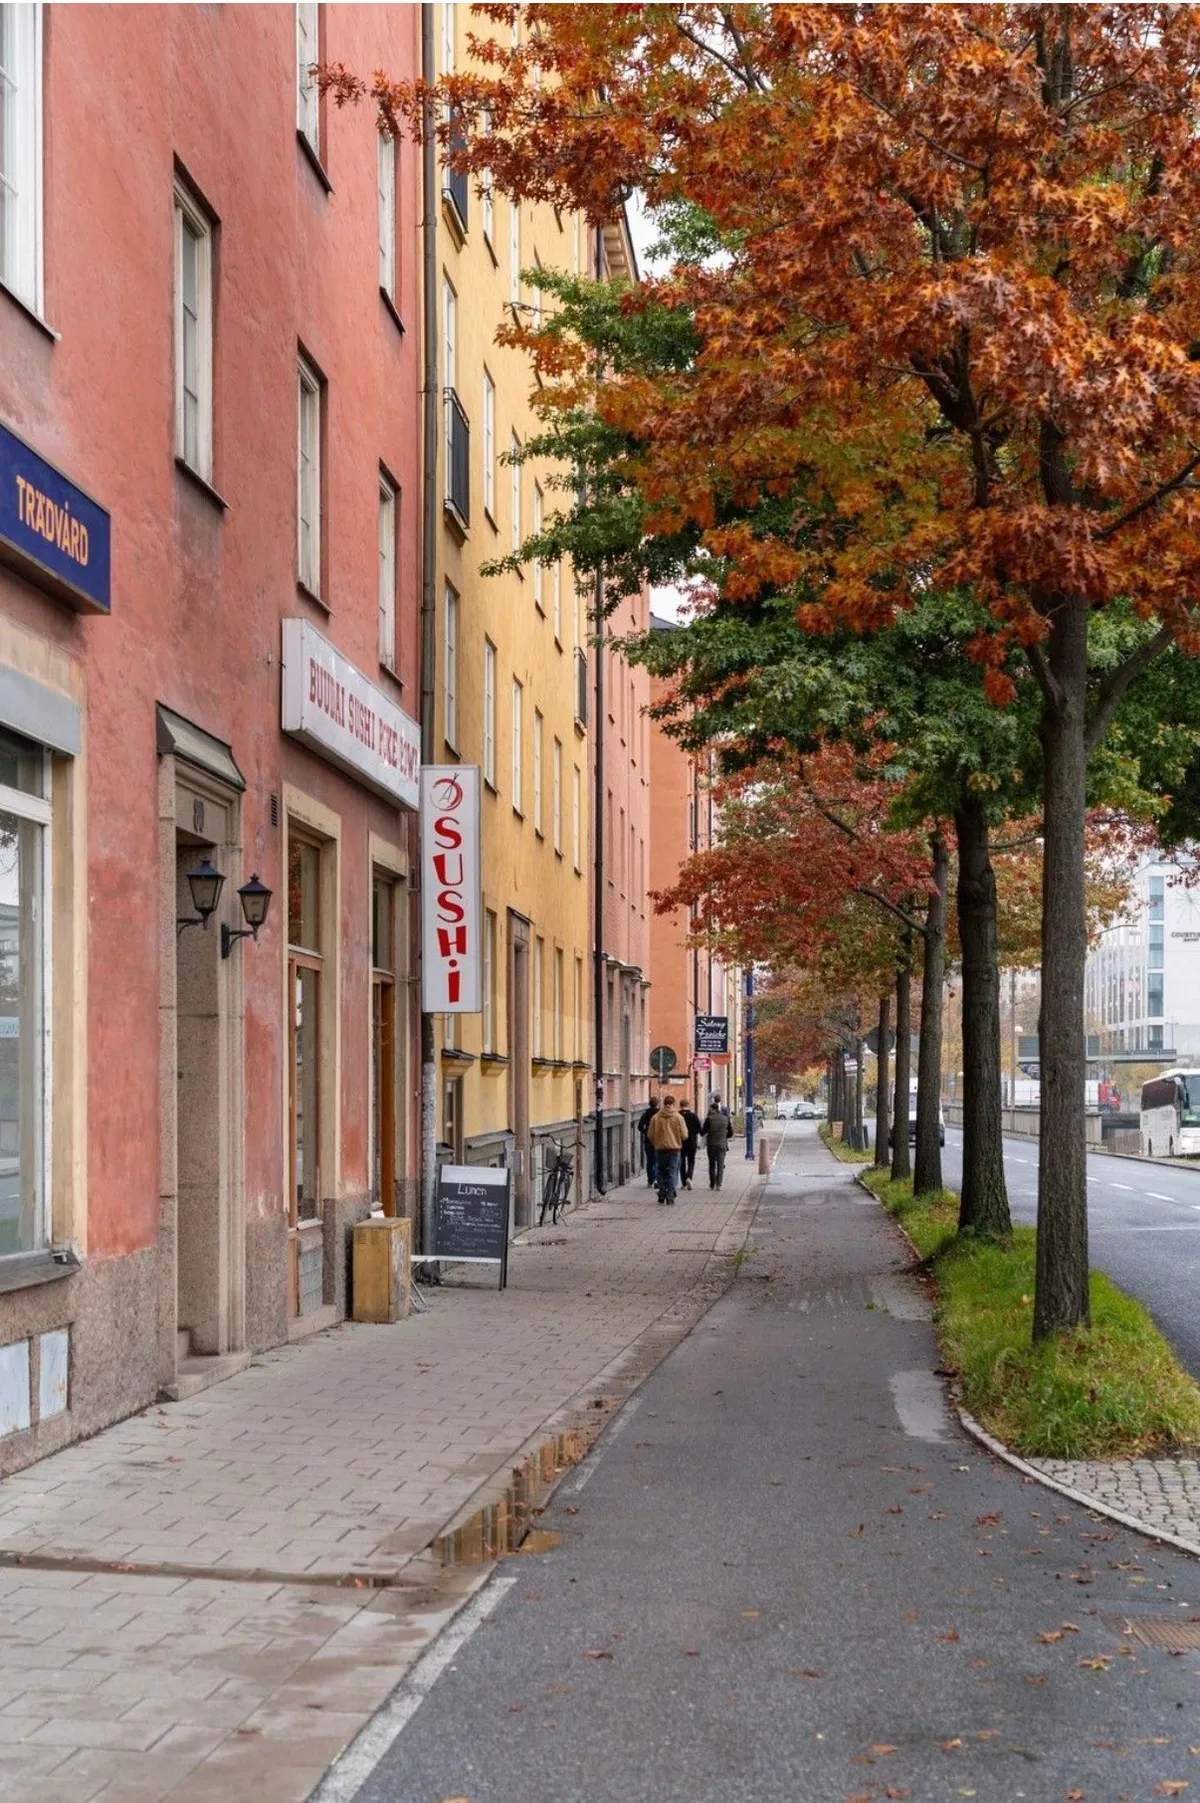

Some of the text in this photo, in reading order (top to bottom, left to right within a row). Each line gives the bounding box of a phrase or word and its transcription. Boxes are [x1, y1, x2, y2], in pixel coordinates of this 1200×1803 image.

[16, 475, 88, 567] TRÄDVÅRD
[348, 692, 376, 750] SUSHI
[432, 816, 467, 1004] SUSHI
[457, 1183, 487, 1196] Lunch
